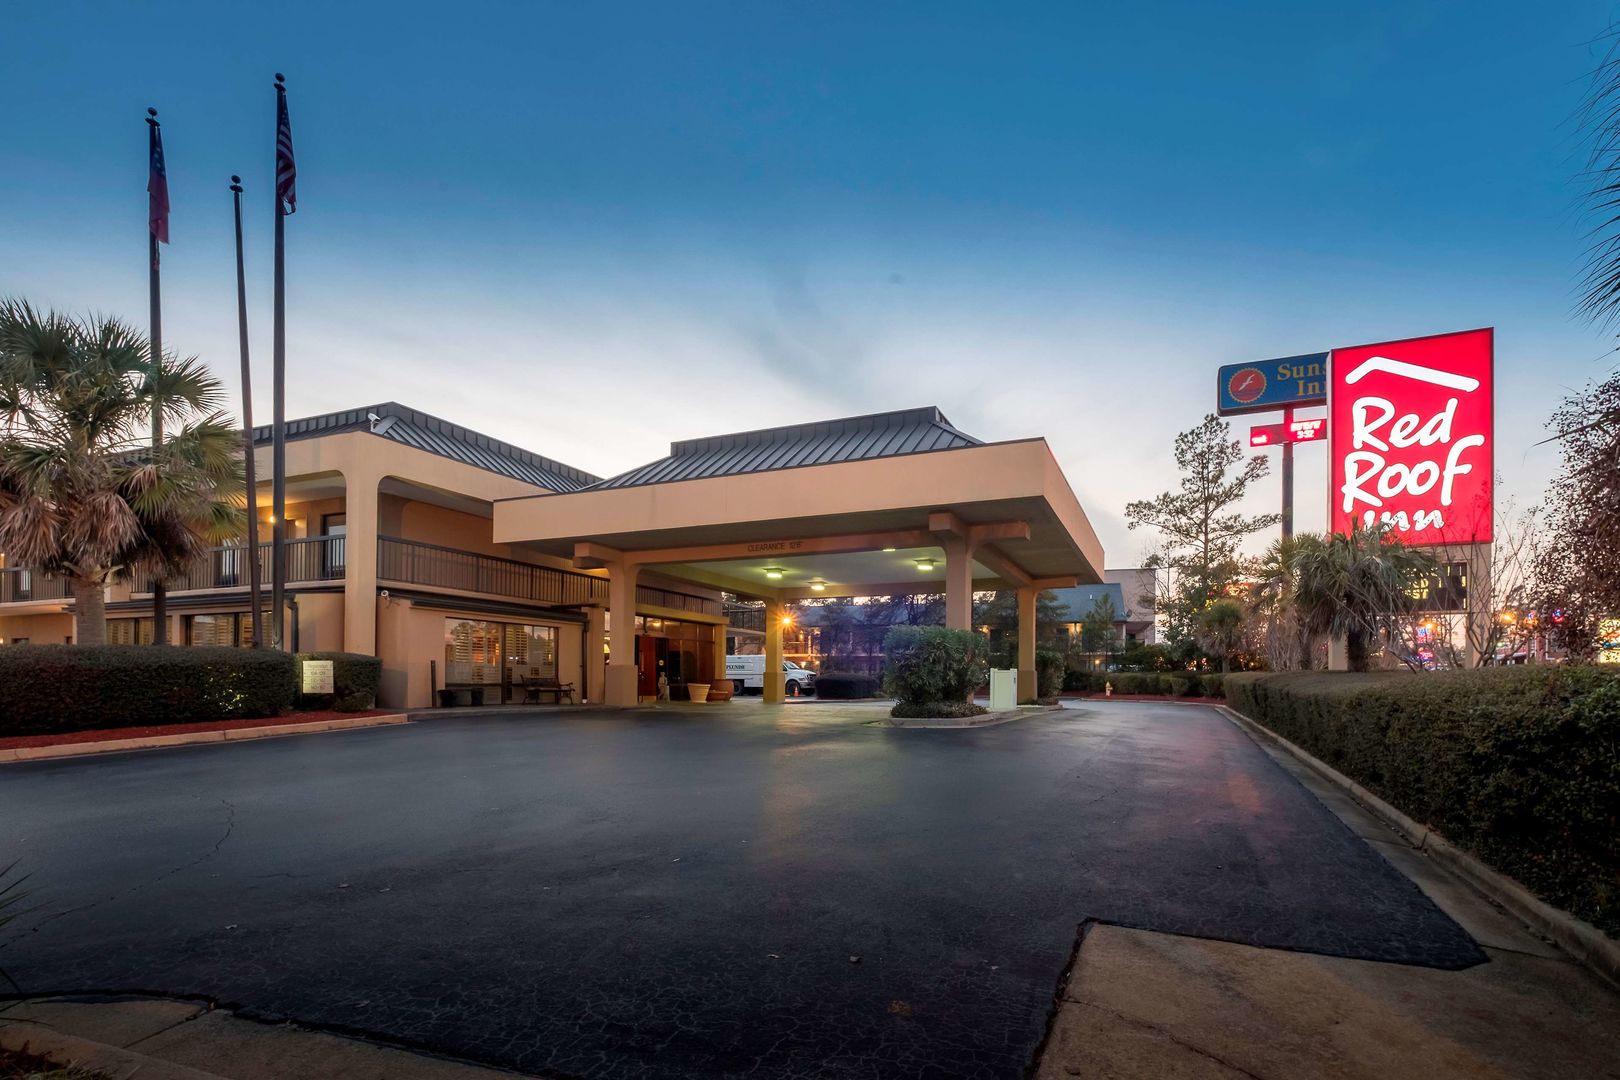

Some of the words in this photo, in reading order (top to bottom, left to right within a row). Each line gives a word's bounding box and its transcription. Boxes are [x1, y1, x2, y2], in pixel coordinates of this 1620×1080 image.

[1297, 380, 1327, 396] In
[1352, 396, 1459, 452] Red
[1340, 434, 1486, 513] Roof
[747, 542, 785, 552] CLEARANCE
